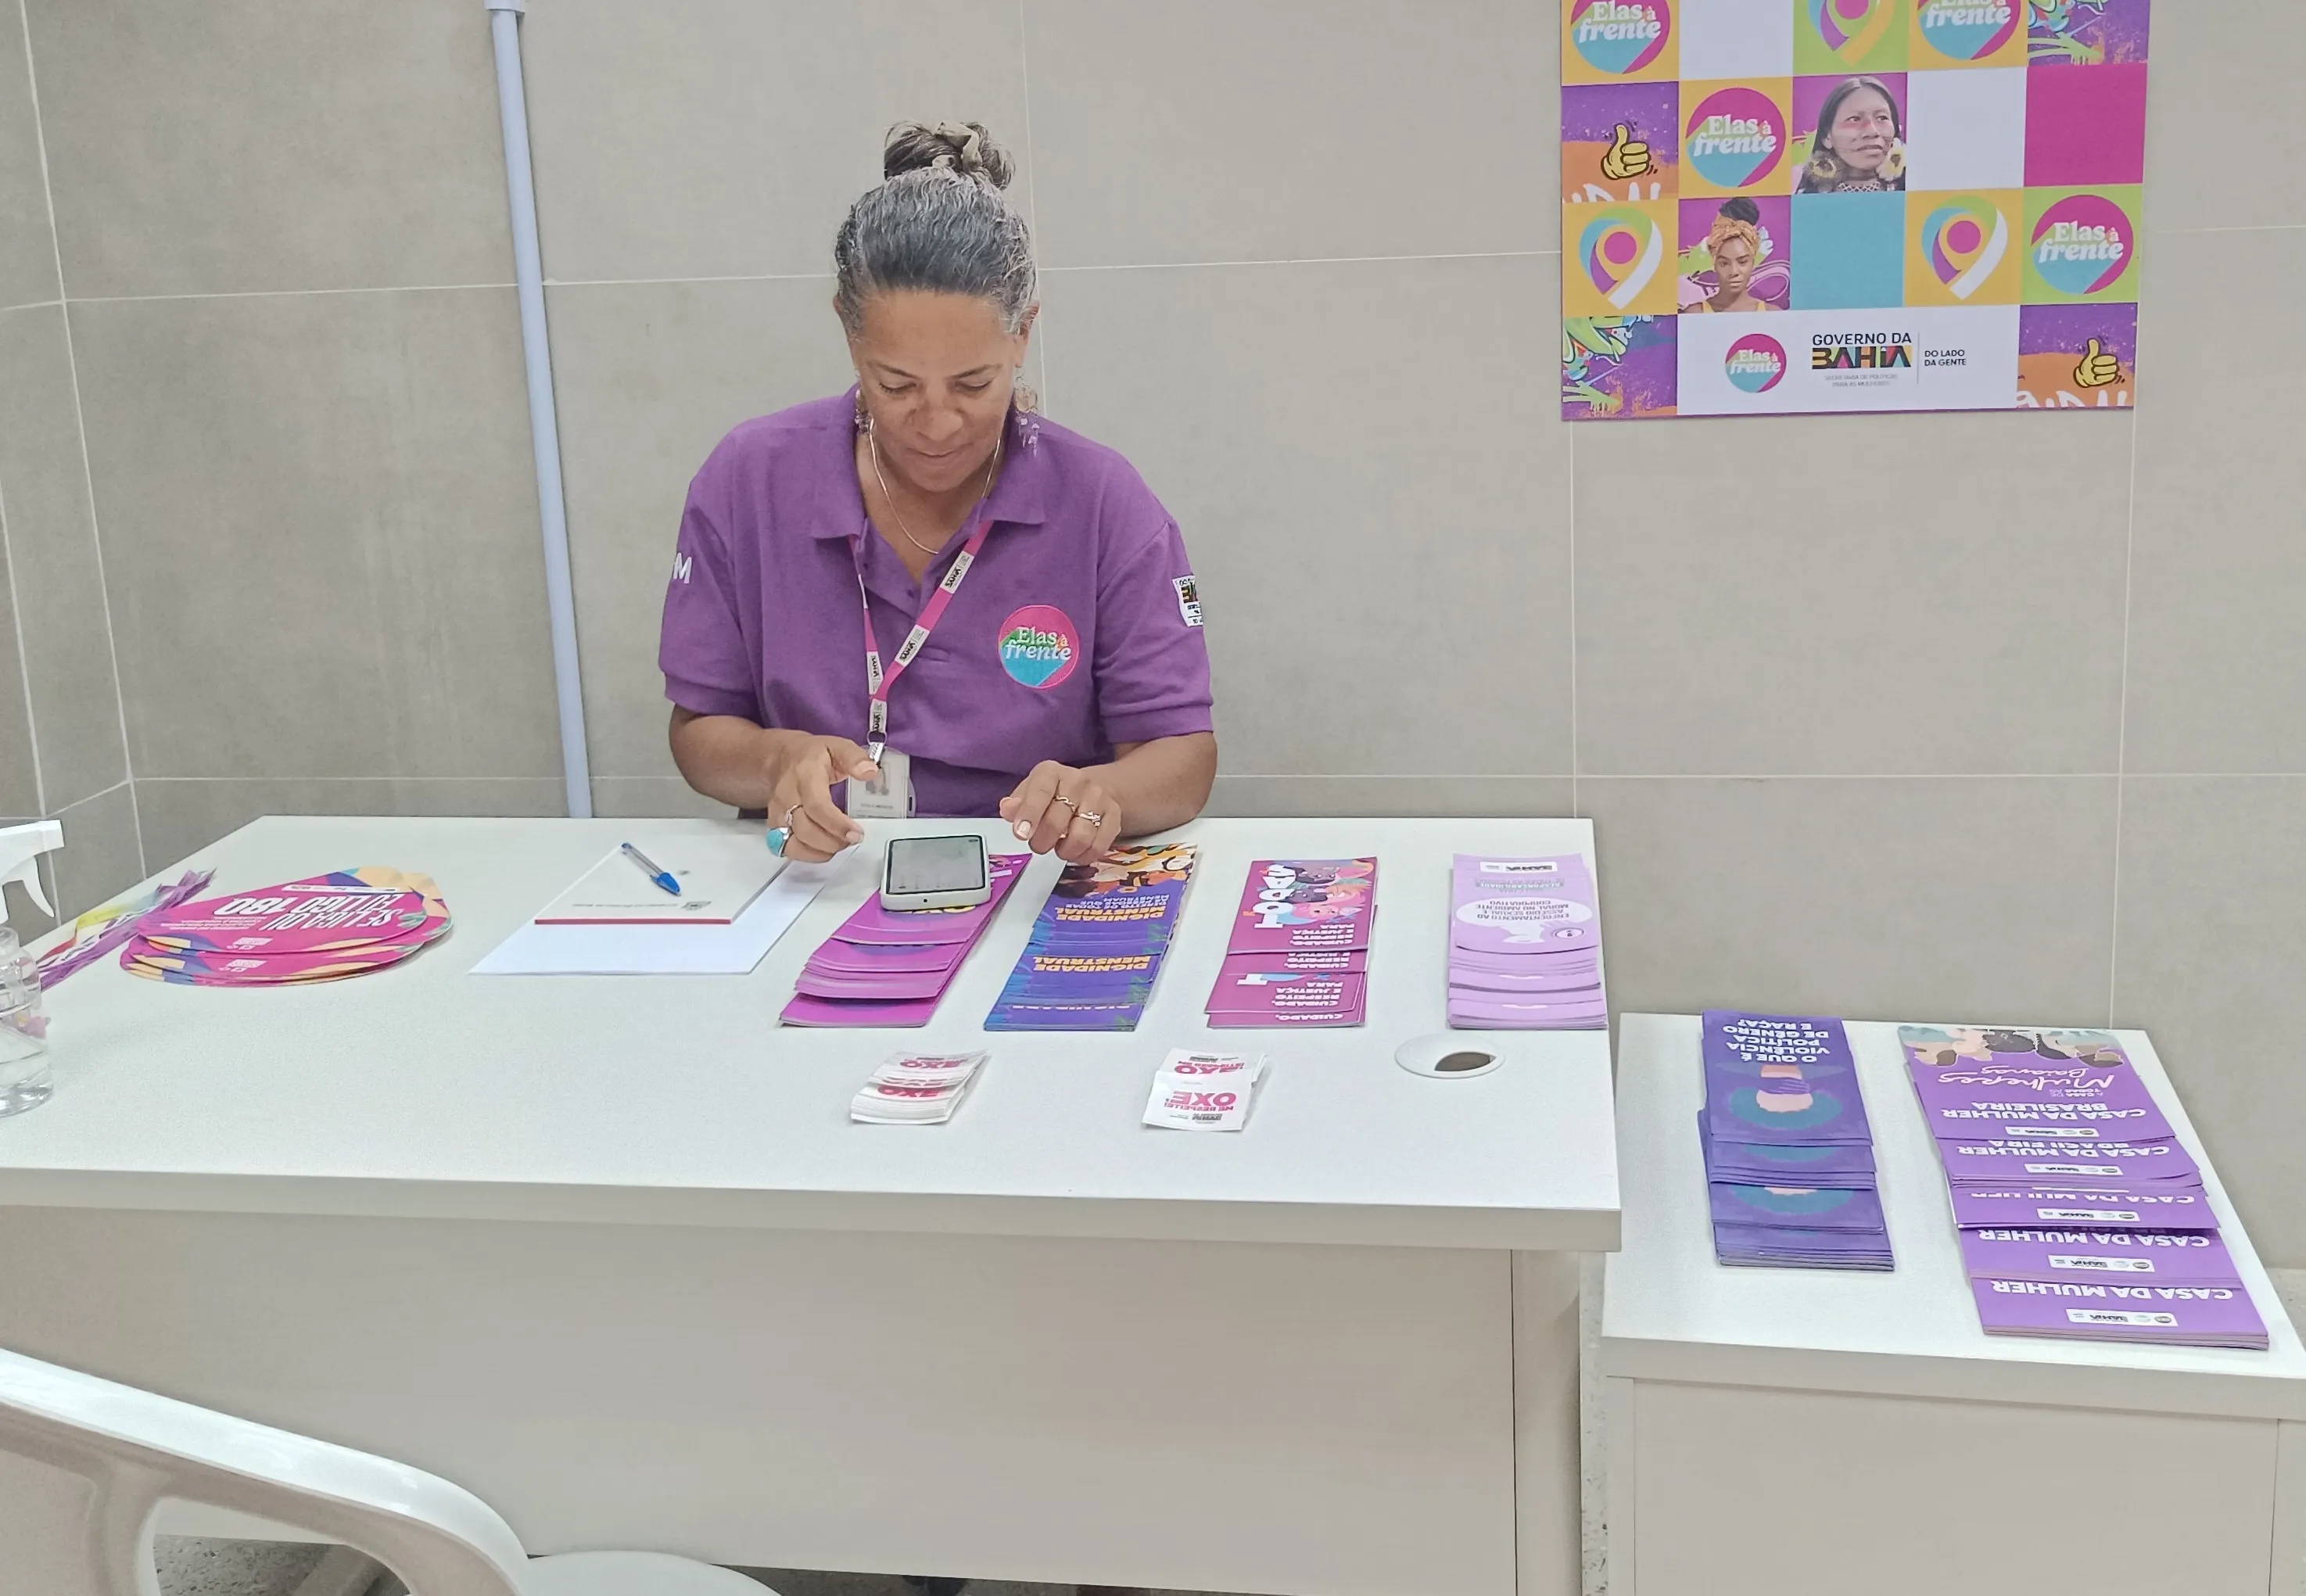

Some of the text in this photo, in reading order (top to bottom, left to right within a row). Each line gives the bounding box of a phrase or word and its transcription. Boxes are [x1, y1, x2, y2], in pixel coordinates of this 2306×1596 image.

[1593, 0, 1643, 21] Elas
[1926, 3, 2011, 28] frente
[1579, 17, 1662, 43] frente
[1707, 113, 1759, 135] Elas
[1693, 131, 1777, 156] frente
[2053, 220, 2106, 242] Elas
[2038, 239, 2124, 263] frente
[1812, 332, 1912, 346] GOVERNO DA
[1738, 349, 1770, 362] Elas
[1812, 345, 1913, 370] BAHIA
[1730, 359, 1781, 375] frente
[1017, 626, 1058, 644] Elas
[1005, 639, 1071, 661] frente
[212, 894, 405, 915] EU LIGO 180
[1055, 906, 1167, 915] MENSTRUAL
[257, 913, 310, 931] OU
[298, 909, 374, 930] LIGA
[356, 909, 403, 927] SE
[1056, 911, 1164, 921] DIGNIDADE
[1032, 956, 1152, 965] MENSTRUAL
[1034, 963, 1149, 972] DIGNIDADE
[1738, 1019, 1797, 1030] RAÇA?
[1723, 1025, 1800, 1039] GÊNERO
[1733, 1035, 1820, 1047] POLÍTICA
[1726, 1042, 1831, 1056] VIOLÊNCIA
[1740, 1052, 1752, 1062] É
[1756, 1053, 1798, 1063] QUE
[1981, 1065, 2089, 1078] Baianas
[1938, 1072, 2115, 1091] Mulheres
[1940, 1108, 2146, 1120] CASA DA MULHER
[1971, 1103, 2108, 1111] BRASILEIRA
[1956, 1146, 2170, 1158] CASA DA MULHER
[1978, 1230, 2089, 1243] MULHER
[2091, 1233, 2132, 1246] DA
[2135, 1235, 2210, 1247] CASA
[1990, 1281, 2233, 1300] CASA DA MULHER
